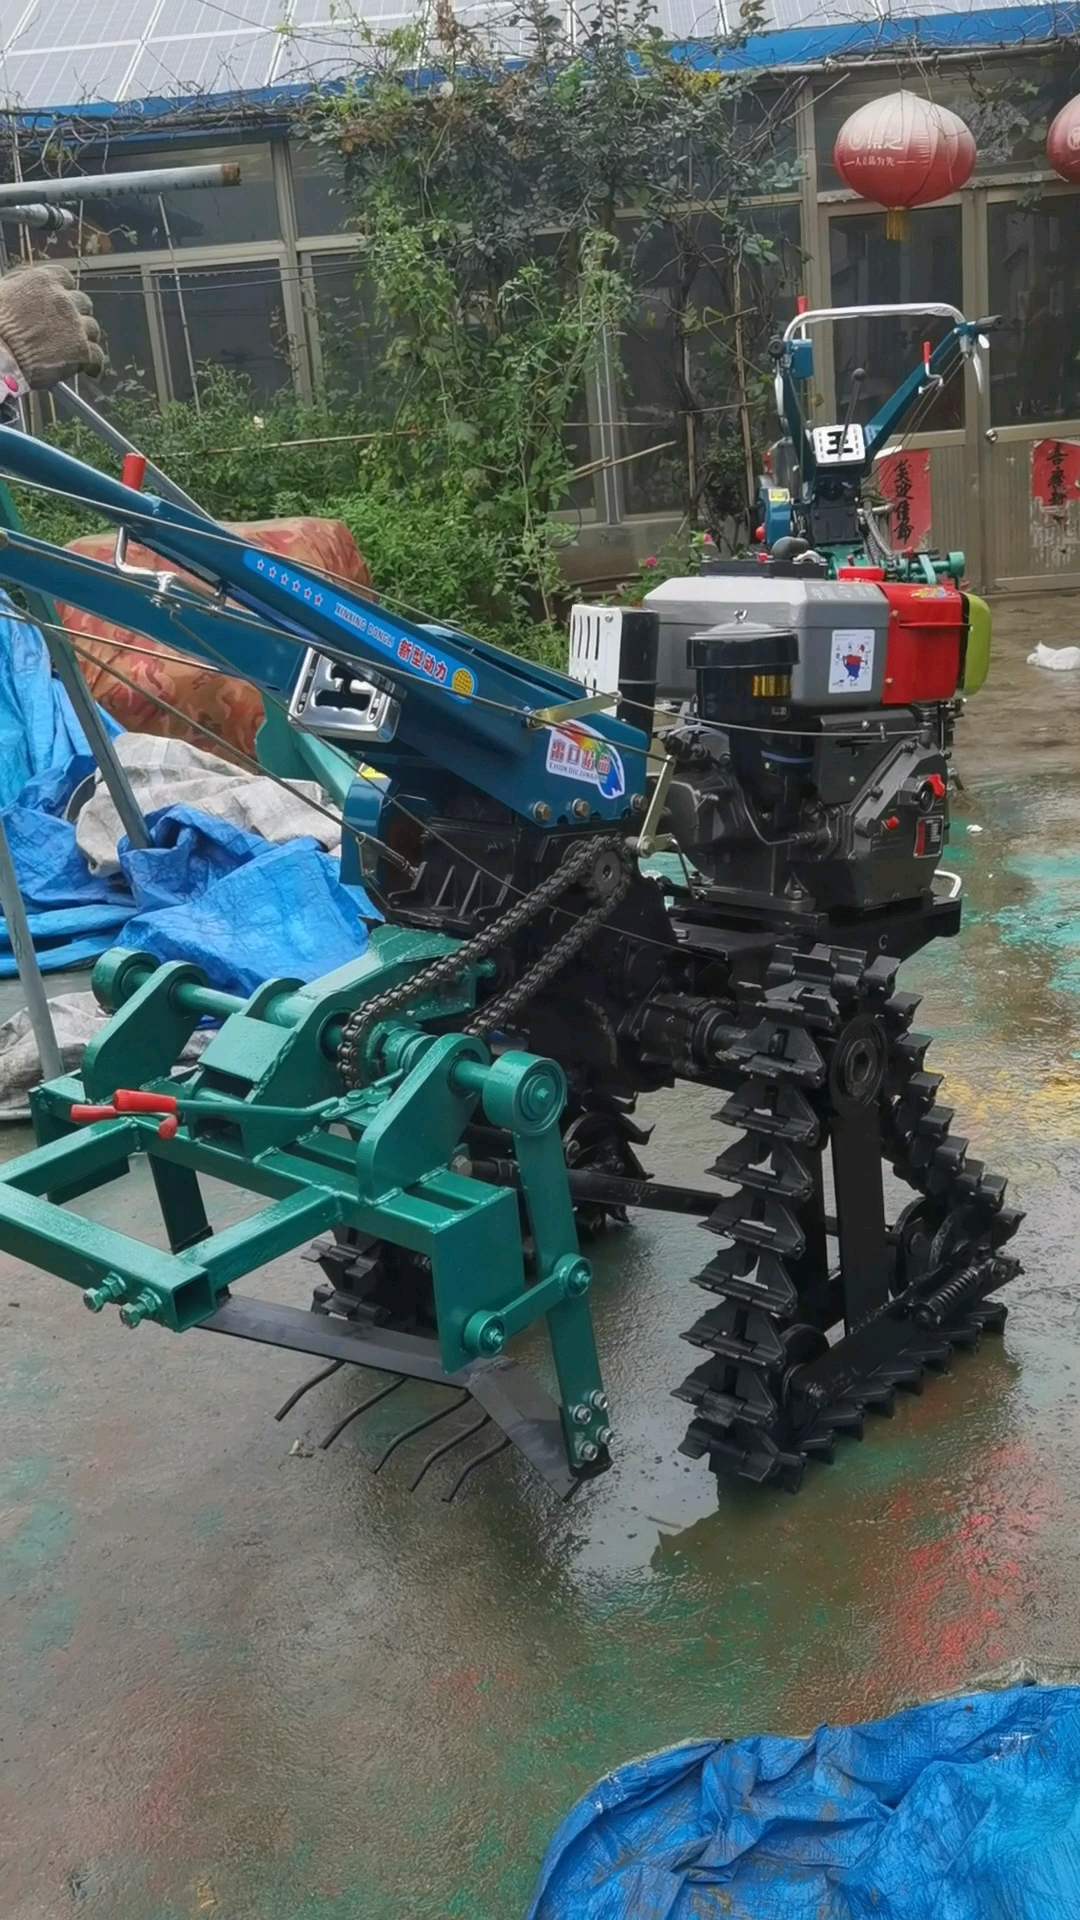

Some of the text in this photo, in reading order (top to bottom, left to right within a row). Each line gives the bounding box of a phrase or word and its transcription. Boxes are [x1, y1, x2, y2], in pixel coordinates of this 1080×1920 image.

[334, 602, 395, 648] XINXING DONGLI
[397, 638, 448, 683] 新型动力
